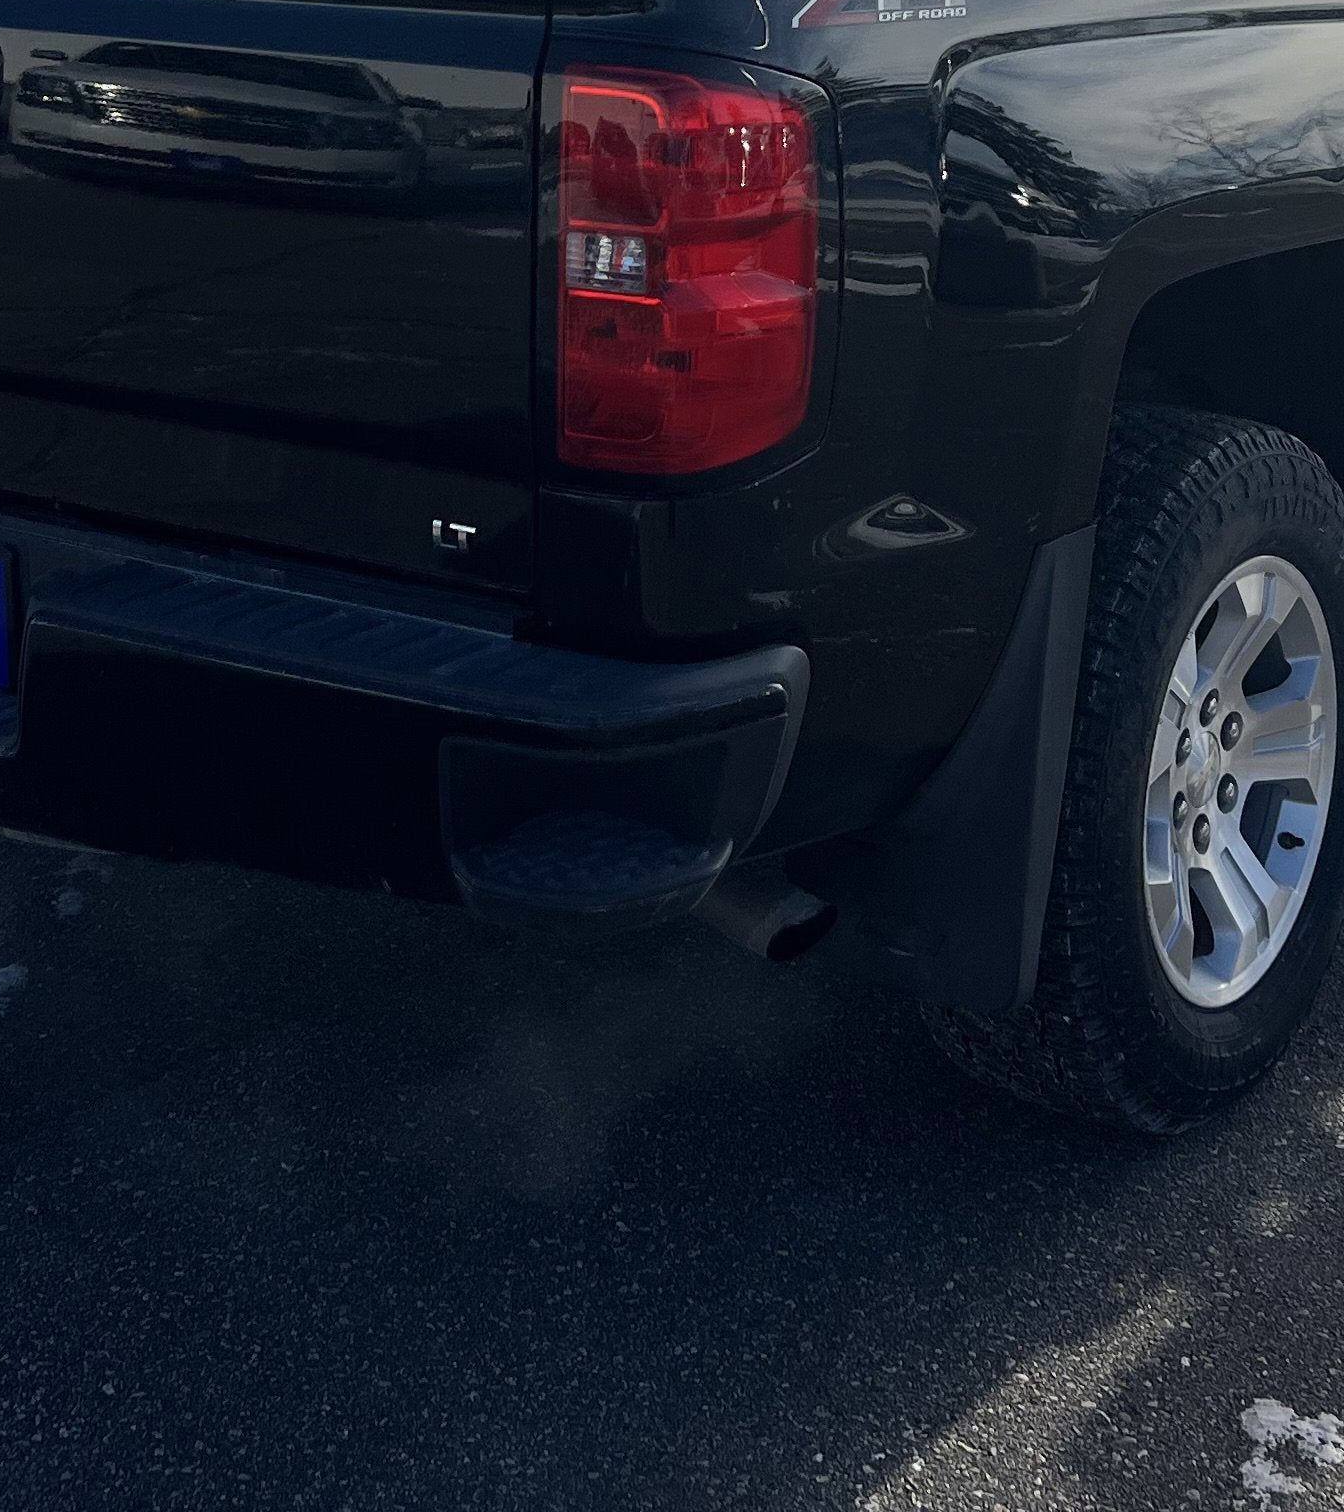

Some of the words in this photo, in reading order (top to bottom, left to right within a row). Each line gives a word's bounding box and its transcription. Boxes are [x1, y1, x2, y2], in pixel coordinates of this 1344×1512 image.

[878, 10, 913, 22] OFF
[918, 7, 967, 19] ROAD
[432, 519, 476, 553] LT
